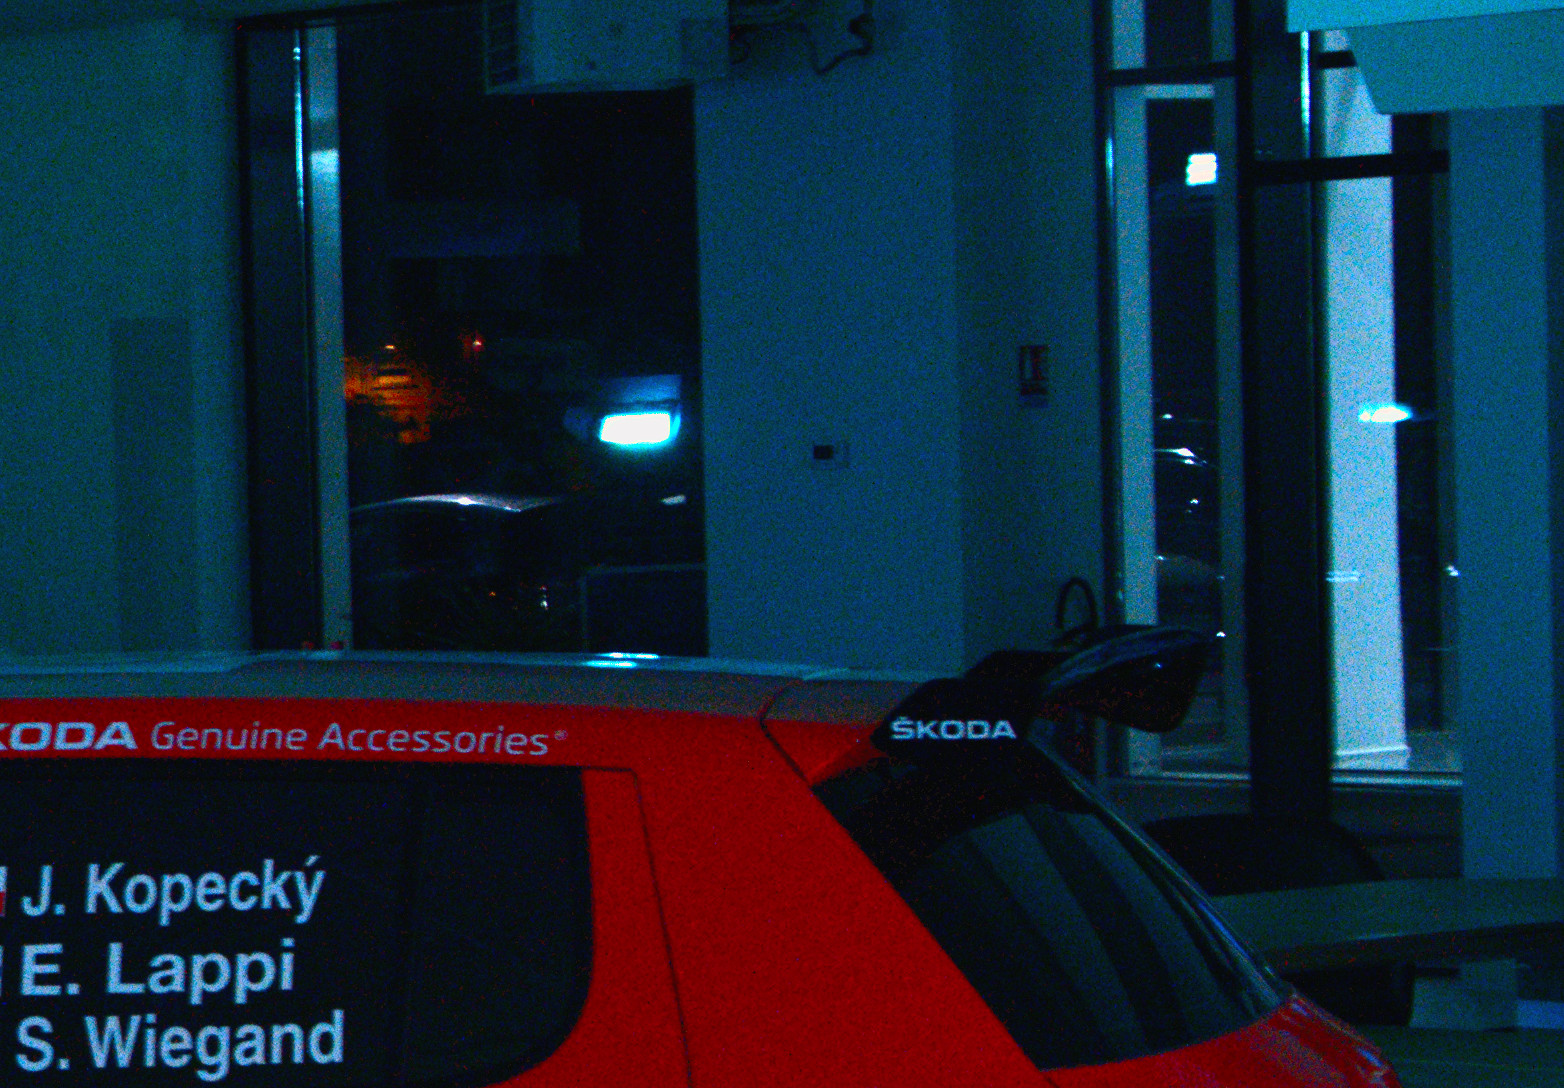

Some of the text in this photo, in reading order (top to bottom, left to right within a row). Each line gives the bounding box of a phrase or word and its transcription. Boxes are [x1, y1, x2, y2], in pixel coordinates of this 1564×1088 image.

[150, 721, 308, 751] Genuine
[890, 717, 1017, 740] ŠKODA
[21, 855, 326, 925] J. Kopecký
[21, 937, 295, 1004] E. Lappi
[15, 1009, 344, 1082] S. Wiegand
